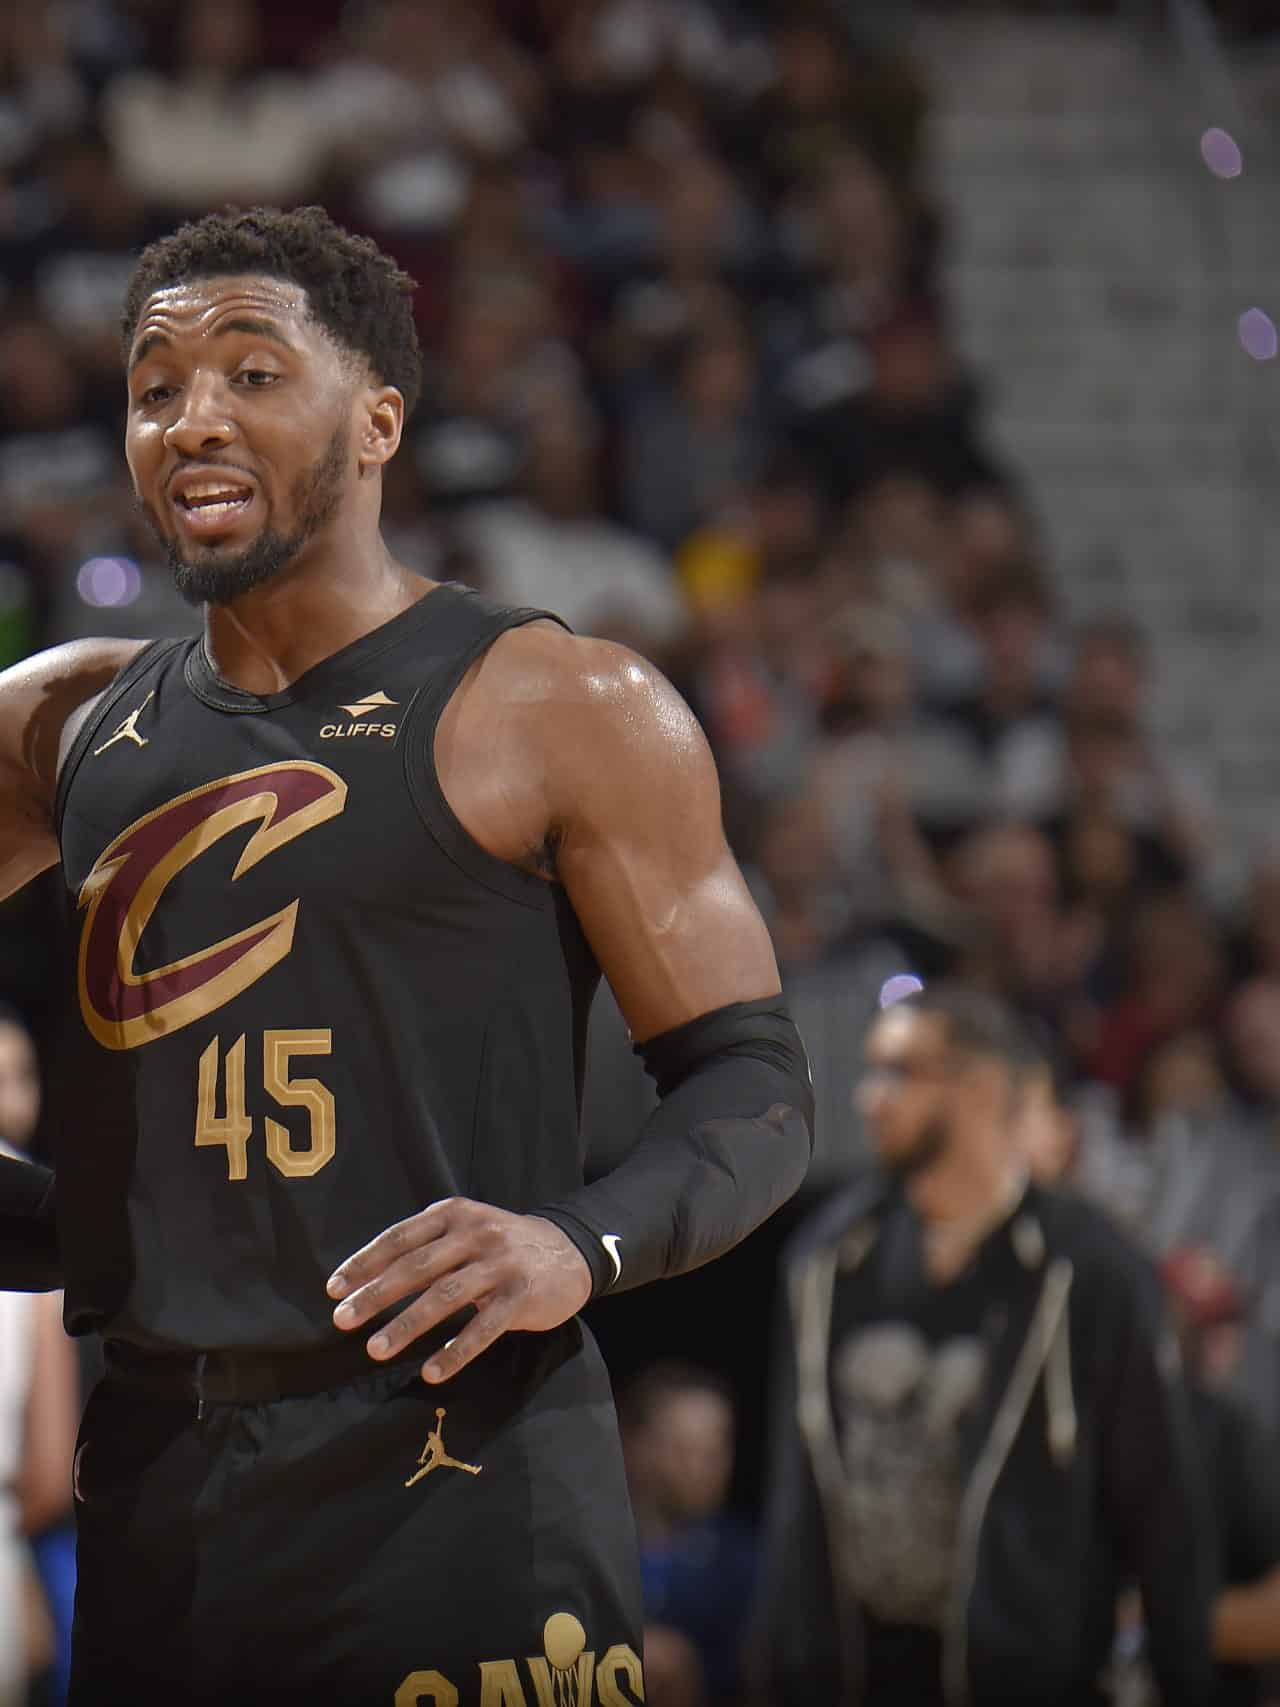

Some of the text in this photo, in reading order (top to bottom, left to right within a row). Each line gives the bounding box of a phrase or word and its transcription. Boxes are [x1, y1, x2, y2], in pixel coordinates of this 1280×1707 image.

[320, 723, 397, 738] CLIFFS
[77, 760, 348, 1051] C
[194, 1028, 336, 1181] 45
